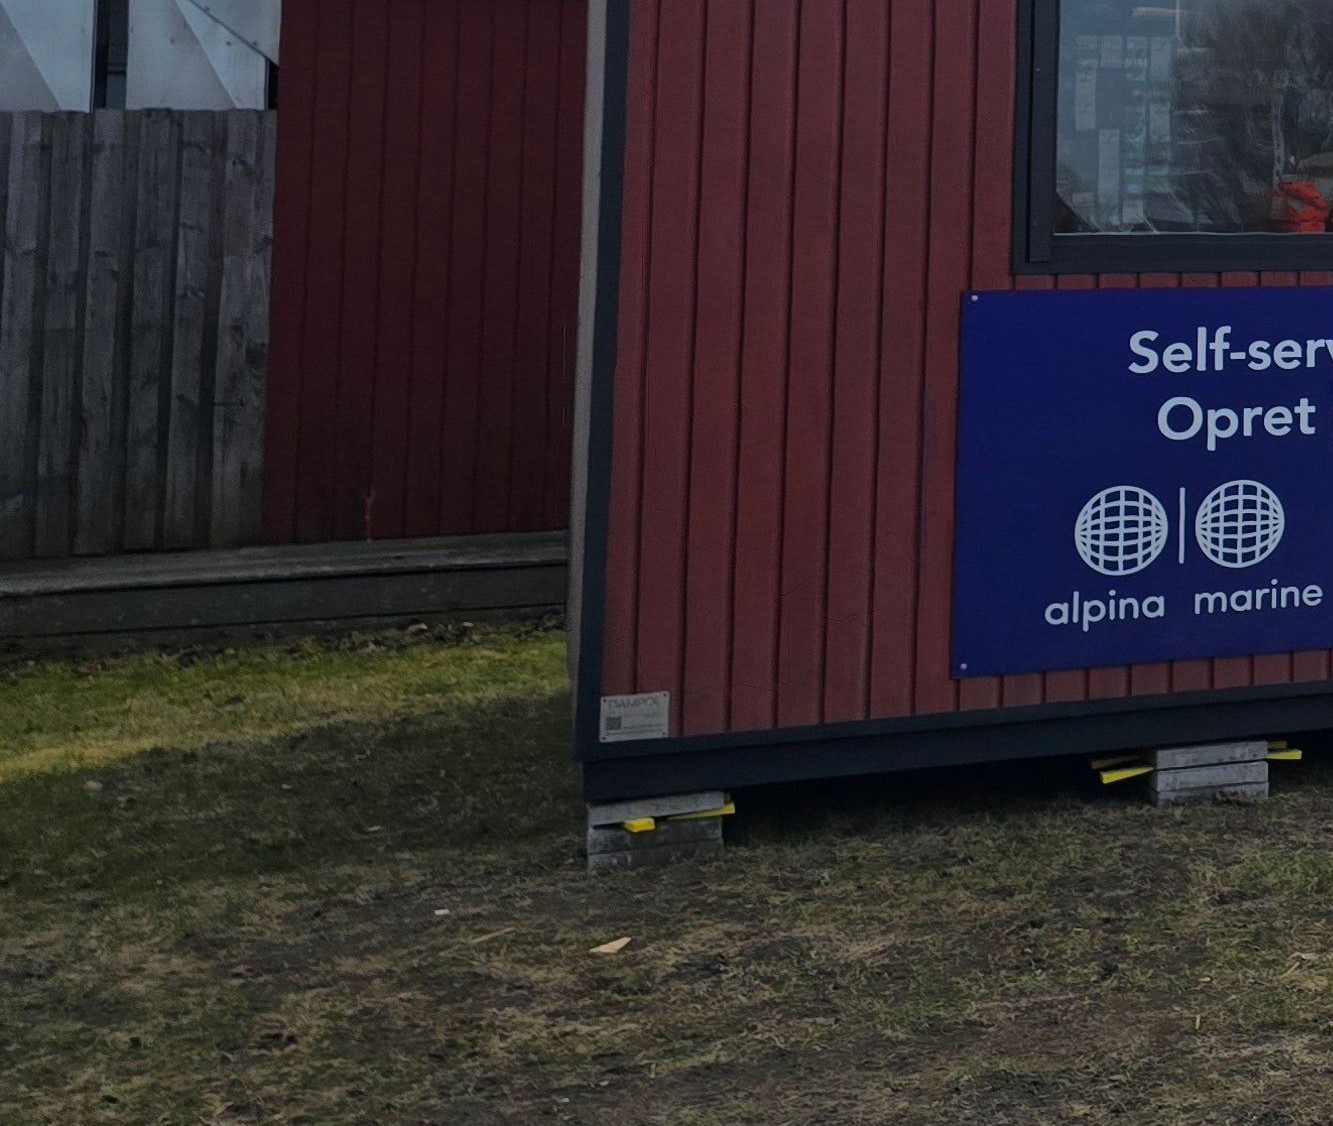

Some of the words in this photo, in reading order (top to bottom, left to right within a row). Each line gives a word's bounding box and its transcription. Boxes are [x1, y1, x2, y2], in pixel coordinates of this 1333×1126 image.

[1157, 396, 1316, 451] Opret
[1044, 589, 1165, 632] alpina
[1194, 578, 1323, 615] marine
